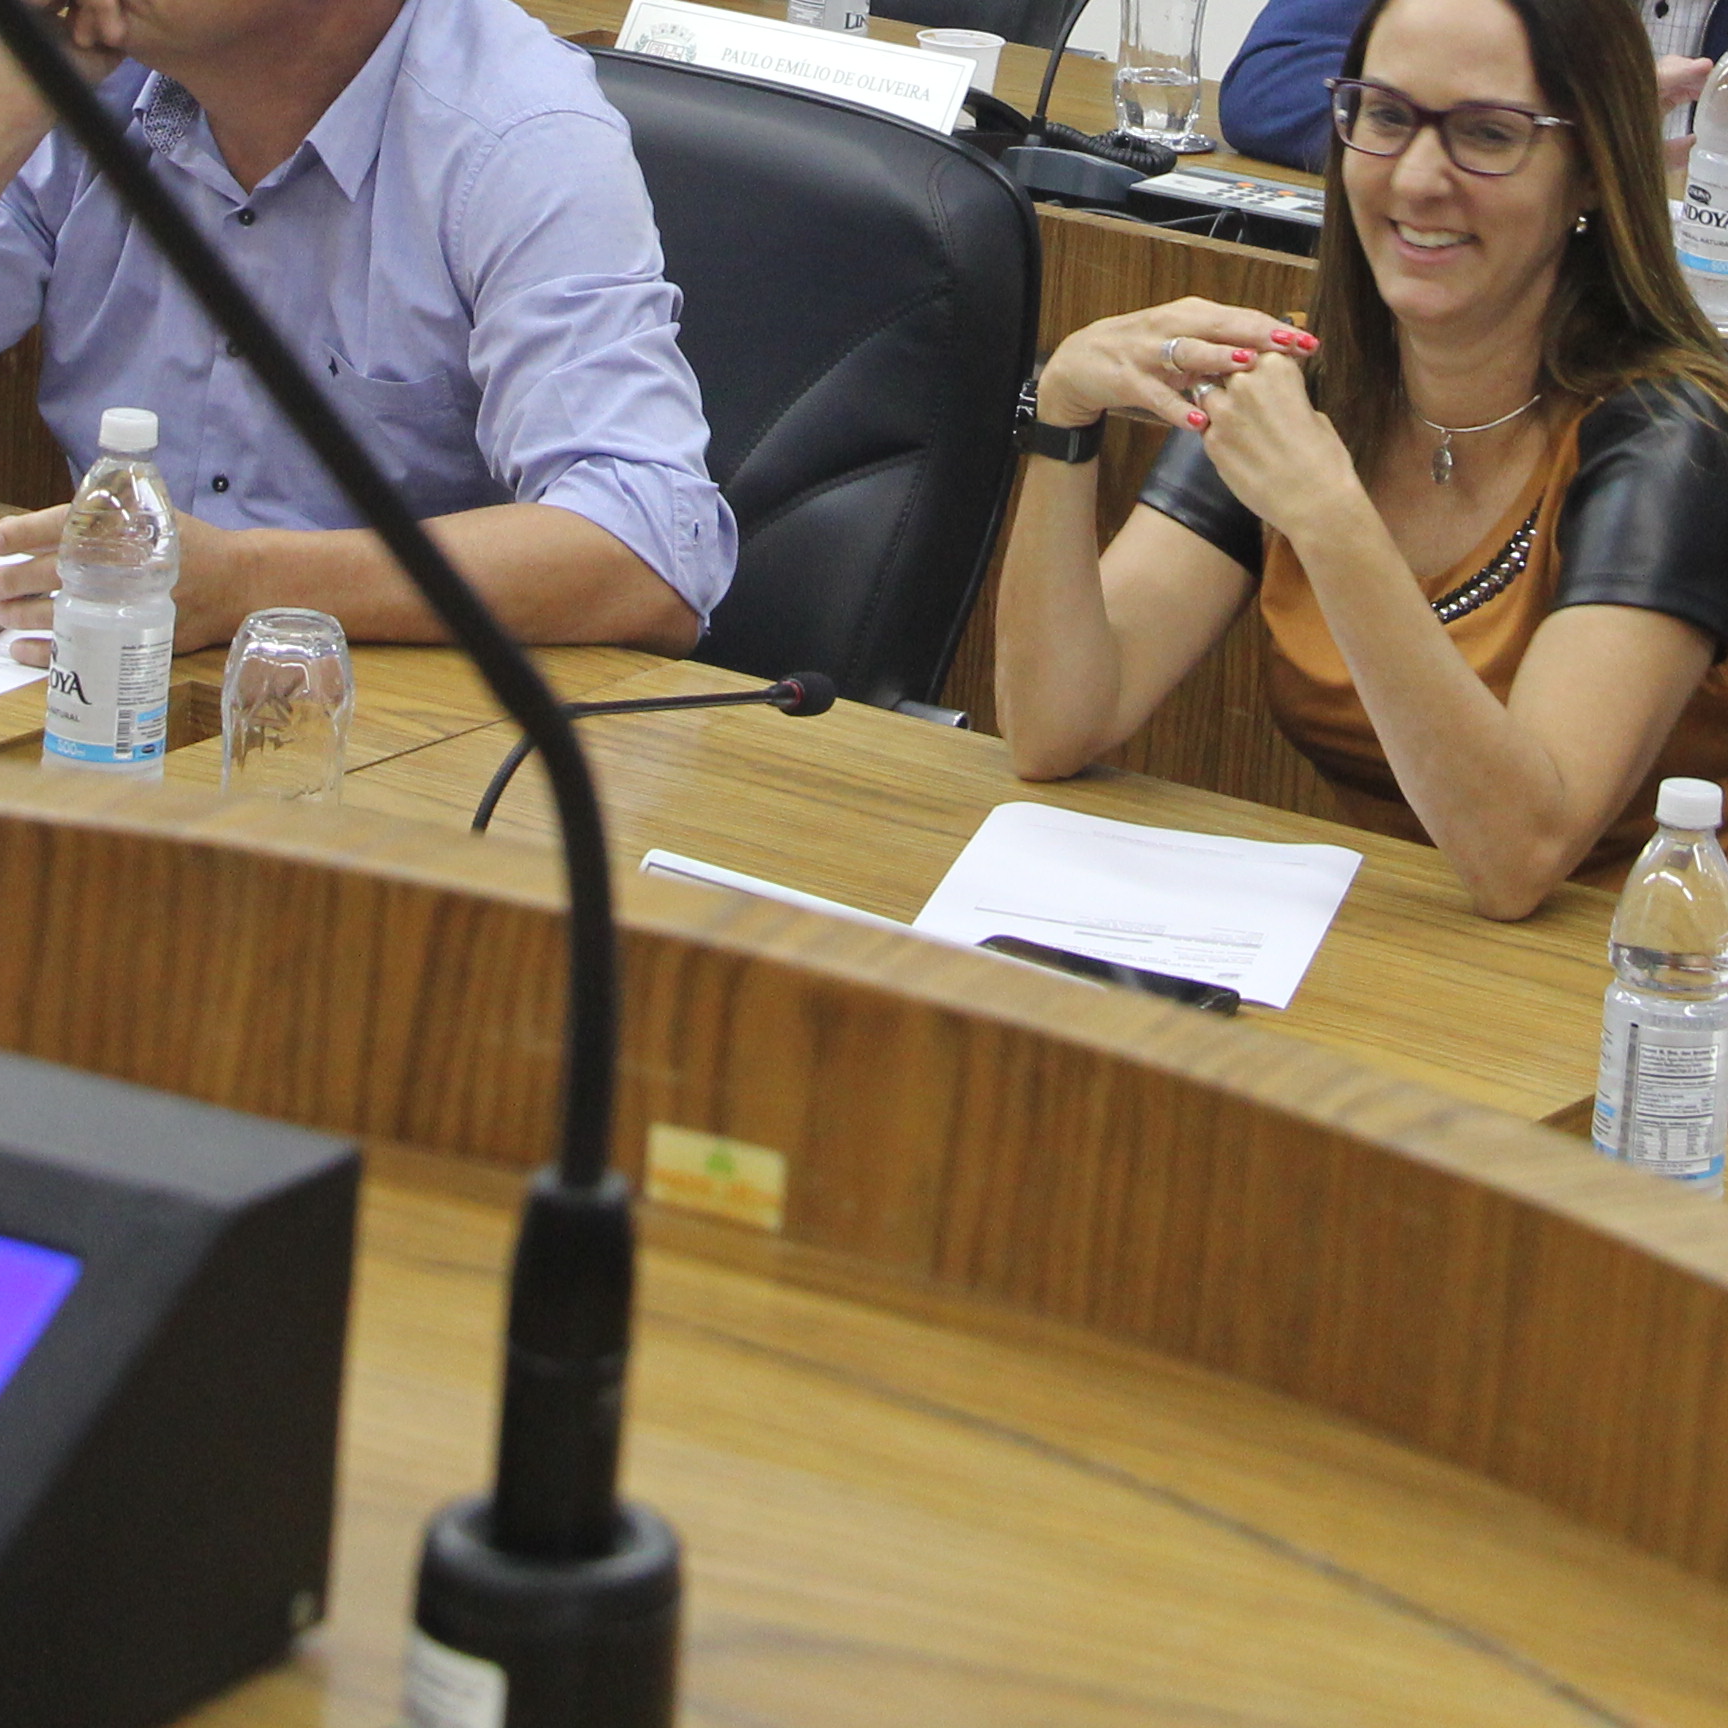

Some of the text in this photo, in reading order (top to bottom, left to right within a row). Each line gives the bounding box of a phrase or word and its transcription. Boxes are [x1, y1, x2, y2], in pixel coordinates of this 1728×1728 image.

[721, 47, 931, 102] PAULO EMÍLIO DE OLIVEIRA
